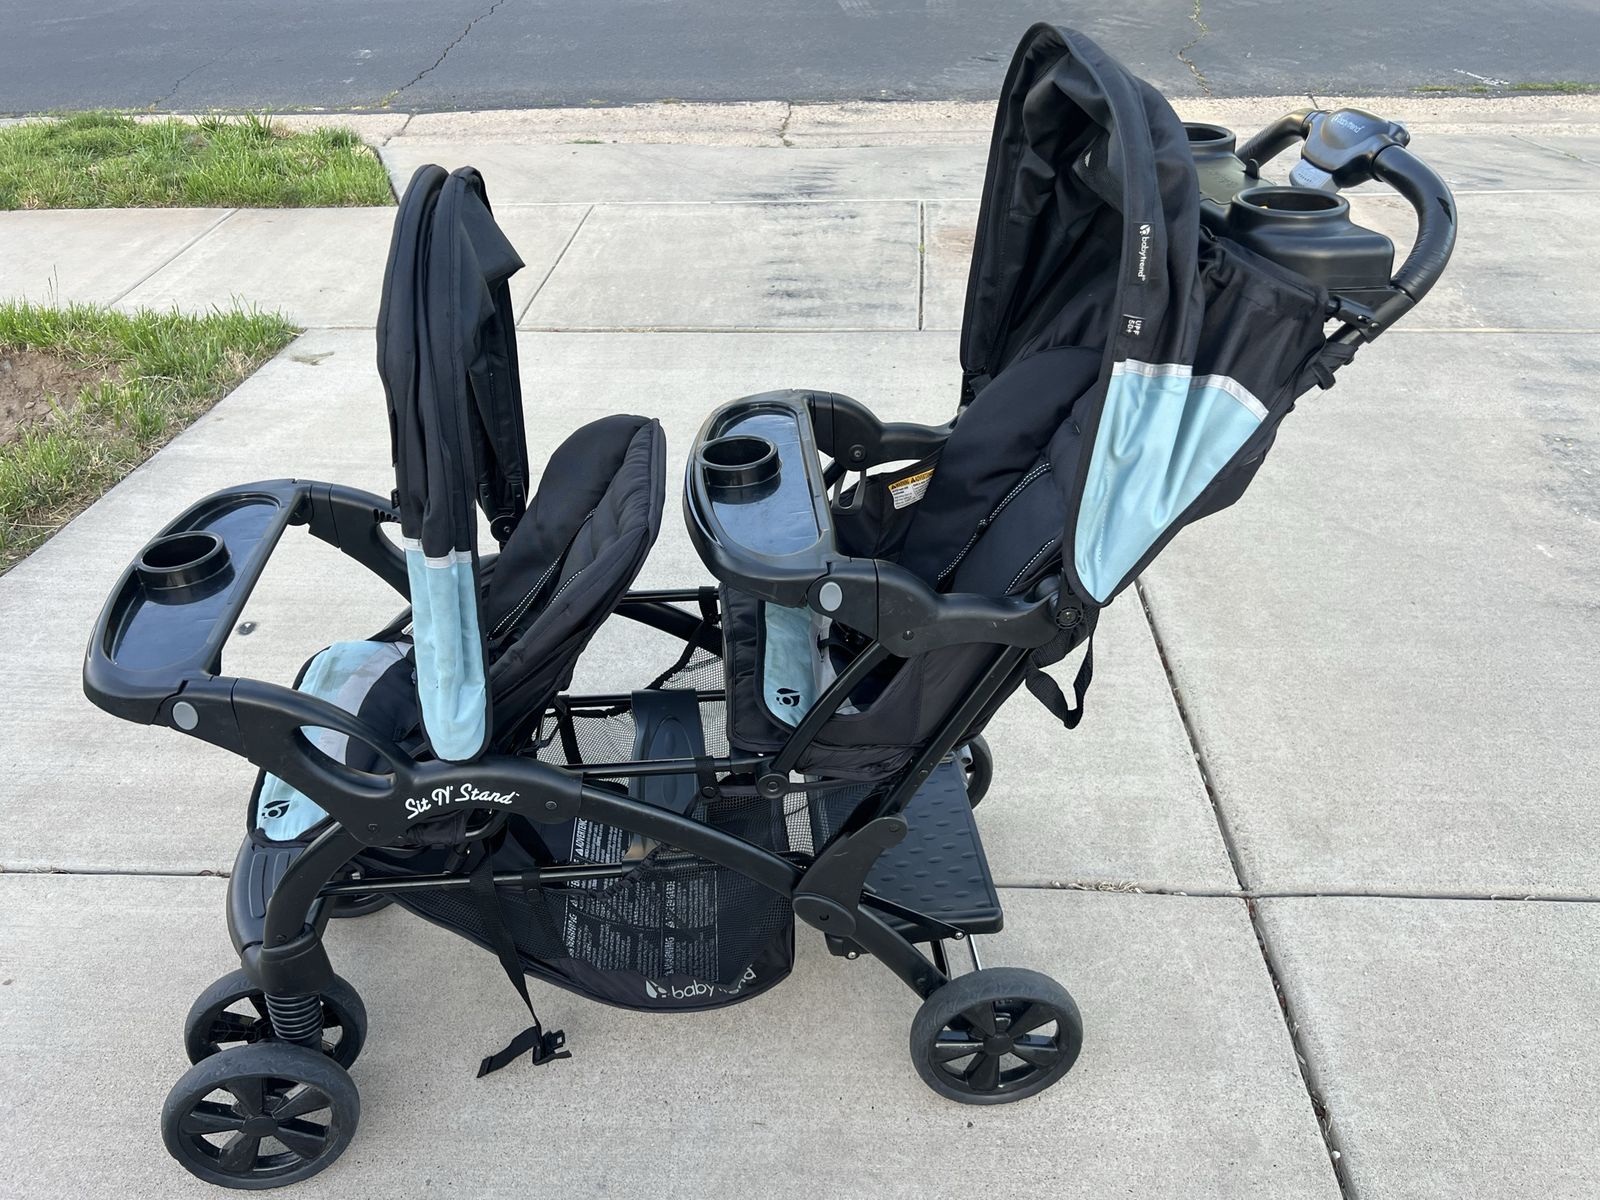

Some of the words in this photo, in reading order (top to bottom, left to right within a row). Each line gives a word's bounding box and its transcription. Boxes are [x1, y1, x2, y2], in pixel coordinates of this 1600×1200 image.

[1133, 319, 1142, 336] UPF
[404, 797, 432, 820] Sit
[454, 783, 516, 805] Stand
